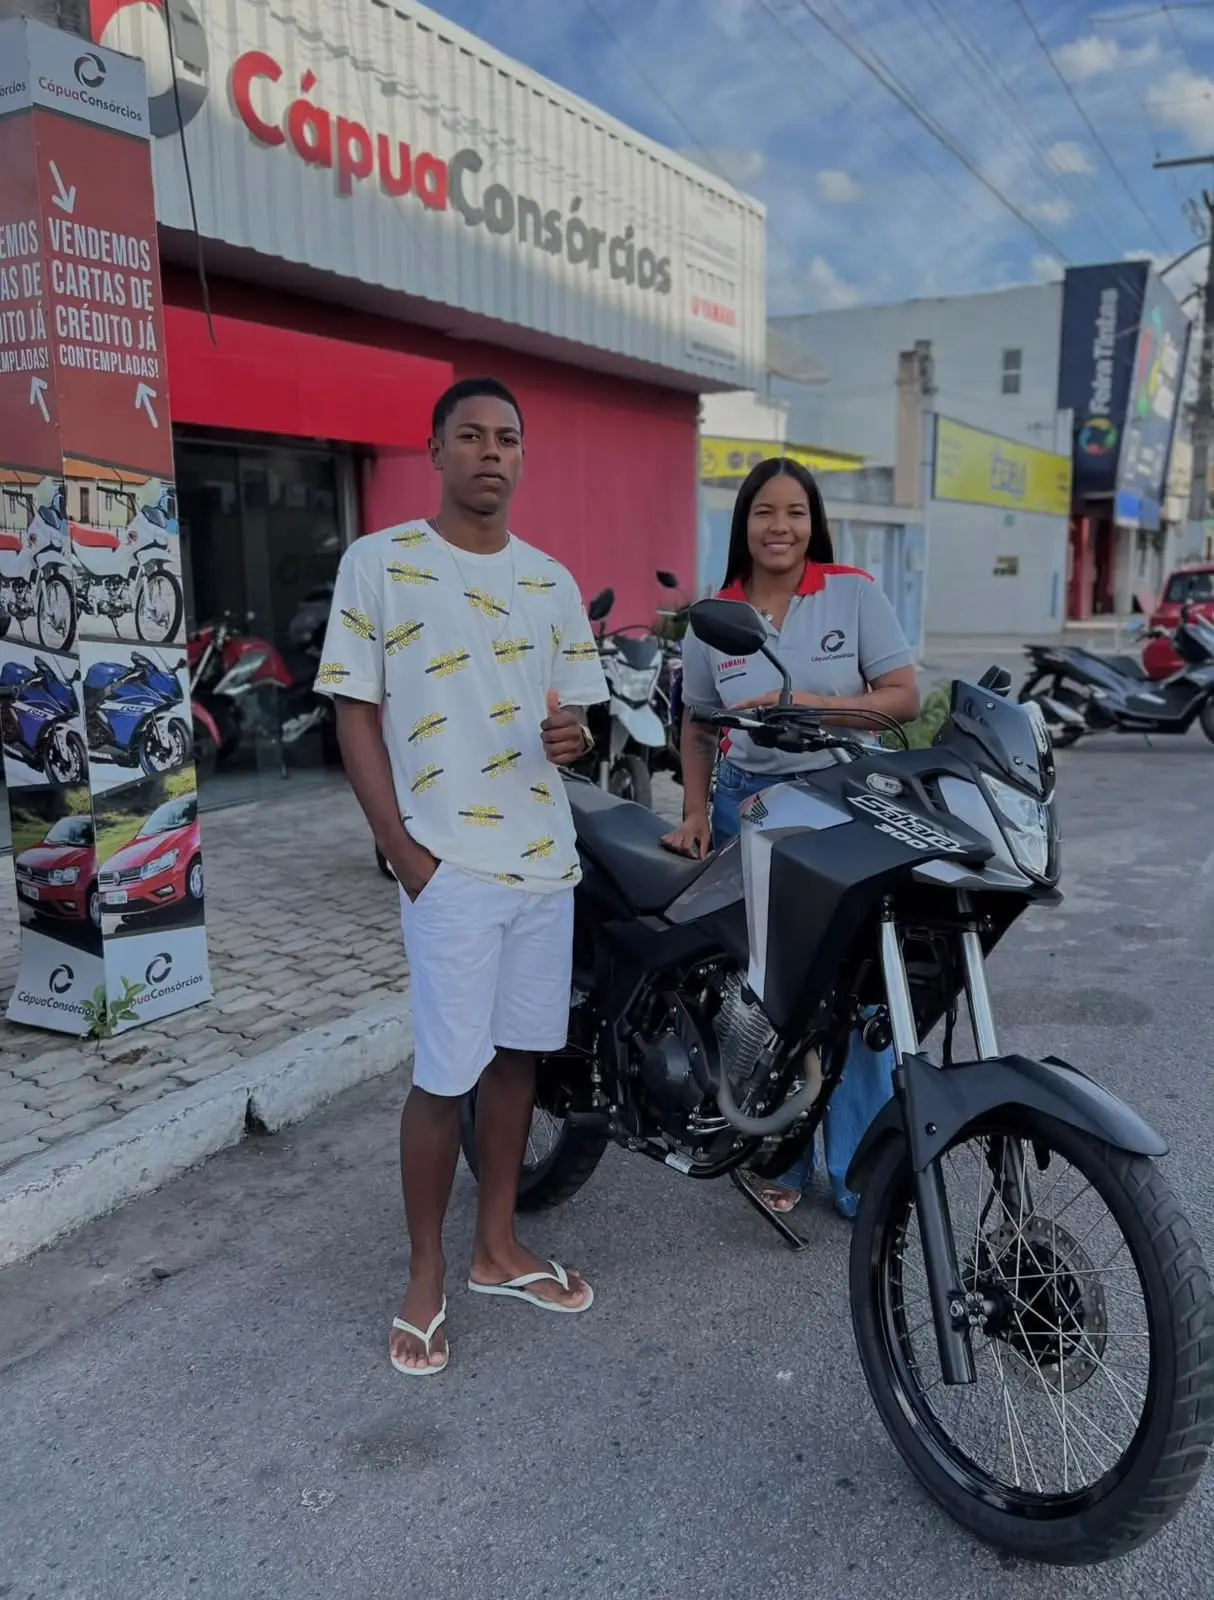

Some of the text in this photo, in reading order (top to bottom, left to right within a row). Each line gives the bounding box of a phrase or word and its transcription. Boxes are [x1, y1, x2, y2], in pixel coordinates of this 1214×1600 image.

[38, 76, 143, 122] CápuaConsórcios
[48, 216, 151, 272] VENDEMOS
[22, 262, 43, 298] DE
[52, 259, 154, 312] CARTAS DE
[30, 300, 48, 341] JÁ
[55, 303, 158, 352] CRÉDITO JÁ
[59, 344, 160, 379] CONTEMPLADAS!
[720, 657, 747, 670] YAMAHA
[873, 822, 929, 850] 300
